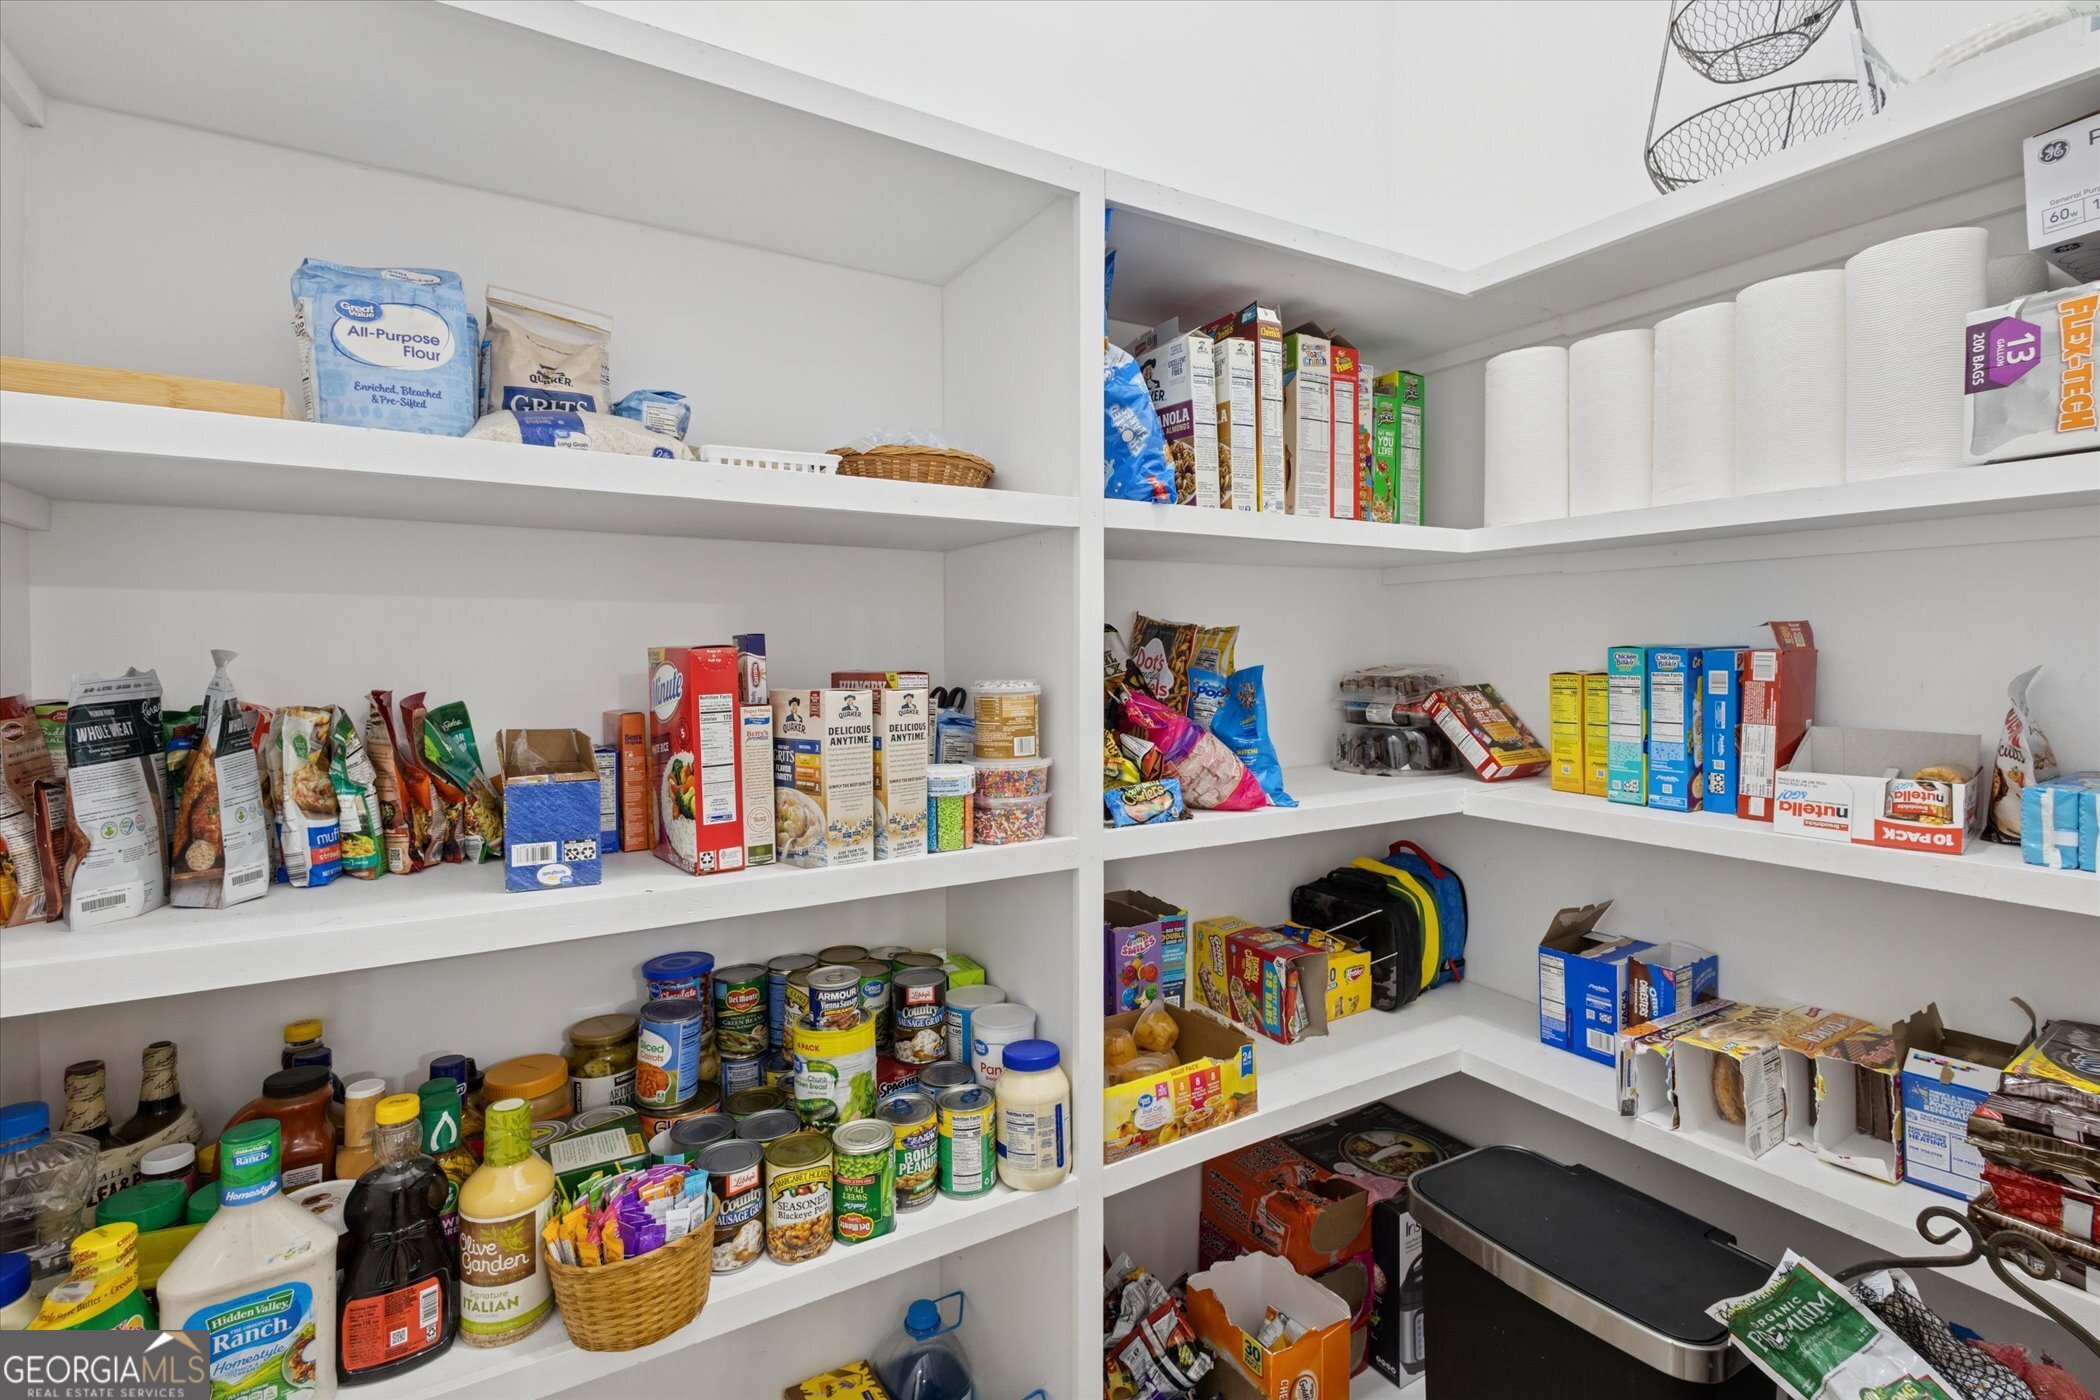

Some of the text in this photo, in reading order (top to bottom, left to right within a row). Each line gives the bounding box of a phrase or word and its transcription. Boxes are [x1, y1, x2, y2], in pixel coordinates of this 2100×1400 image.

[2050, 190, 2082, 206] General
[340, 301, 375, 313] Great
[349, 310, 375, 319] Value
[347, 325, 441, 347] All-Purpose
[403, 346, 441, 361] Flour
[1996, 338, 2005, 367] GALLON
[2007, 332, 2036, 364] 13
[1303, 356, 1327, 367] Crunch
[1972, 332, 1985, 386] 200 BAGS
[2058, 294, 2100, 432] FLEX-TECH
[354, 381, 442, 400] Enriched, Bleached
[371, 394, 427, 409] & Pre-Sifted
[510, 394, 588, 412] GRITS
[1166, 422, 1191, 434] ALMONDS
[572, 441, 588, 449] Grain
[1378, 436, 1394, 447] YOU
[1136, 649, 1165, 673] Dot's
[652, 668, 683, 707] Minute
[838, 711, 862, 719] QUAKER
[76, 724, 111, 742] WHOLE
[783, 723, 806, 734] QUAKER
[828, 725, 871, 736] DELICIOUS
[889, 722, 926, 733] DELICIOUS
[830, 735, 871, 746] ANYTIME.
[891, 732, 926, 742] ANYTIME.
[775, 764, 792, 772] FLAVOR
[1777, 789, 1808, 801] &GO!
[1894, 791, 1944, 803] nutella
[1778, 801, 1849, 819] nutella
[1804, 820, 1840, 829] Breadsticks
[1882, 826, 1954, 847] 10 PACK
[1161, 932, 1185, 941] DOUBLE
[1121, 935, 1156, 956] SMILES
[1214, 936, 1224, 976] Golden
[1243, 949, 1253, 981] Charms
[1251, 957, 1260, 983] Lucky
[660, 988, 697, 1000] Chocolate
[817, 988, 857, 1001] ARMOUR
[864, 984, 882, 992] Great
[911, 990, 932, 999] Libby's
[738, 994, 758, 1003] Monte
[821, 1000, 839, 1009] Vienna
[1265, 970, 1273, 1025] 28 BARS
[1639, 980, 1649, 1017] CAKESTERS
[1649, 987, 1658, 1016] OREO
[902, 1006, 939, 1018] Country
[745, 1015, 763, 1025] BEANS
[899, 1014, 944, 1028] SAUSAGE GRAVY
[640, 1039, 664, 1053] Sliced
[801, 1043, 819, 1052] PACK
[640, 1050, 664, 1062] Carrots
[1243, 1051, 1252, 1061] 24
[1170, 1064, 1199, 1076] VALUE PACK
[1210, 1072, 1216, 1080] 8
[807, 1075, 827, 1083] Chunk
[1179, 1082, 1184, 1091] 8
[1195, 1077, 1200, 1085] 8
[879, 1076, 919, 1098] SPAGHE
[1143, 1107, 1153, 1115] Fruit
[1909, 1133, 1947, 1148] HEATING
[235, 1143, 270, 1156] Hidden Valley
[904, 1141, 937, 1164] BOILE
[236, 1153, 270, 1166] Ranch
[733, 1172, 756, 1188] Libby's
[776, 1172, 808, 1187] MARGARET
[226, 1180, 279, 1201] Homestyle
[842, 1192, 868, 1201] SWEET
[844, 1185, 864, 1193] PEAS
[720, 1187, 762, 1214] Country
[777, 1191, 829, 1211] SEASONED
[777, 1202, 828, 1220] Blackeye Peas
[716, 1211, 750, 1227] AUSAGE
[839, 1221, 871, 1231] Del Monte
[1250, 1221, 1263, 1238] 12
[460, 1232, 498, 1256] Olive
[462, 1252, 530, 1276] Garden
[76, 1276, 134, 1313] Butter Creole
[469, 1289, 509, 1299] Signature
[463, 1295, 519, 1313] ITALIAN
[212, 1299, 290, 1329] Hidden Valley
[1751, 1296, 1802, 1329] ORGANIC
[230, 1318, 271, 1335] THE ORIGINAL
[212, 1317, 292, 1355] Ranch
[1244, 1339, 1261, 1362] 30
[213, 1344, 286, 1376] Homestyle
